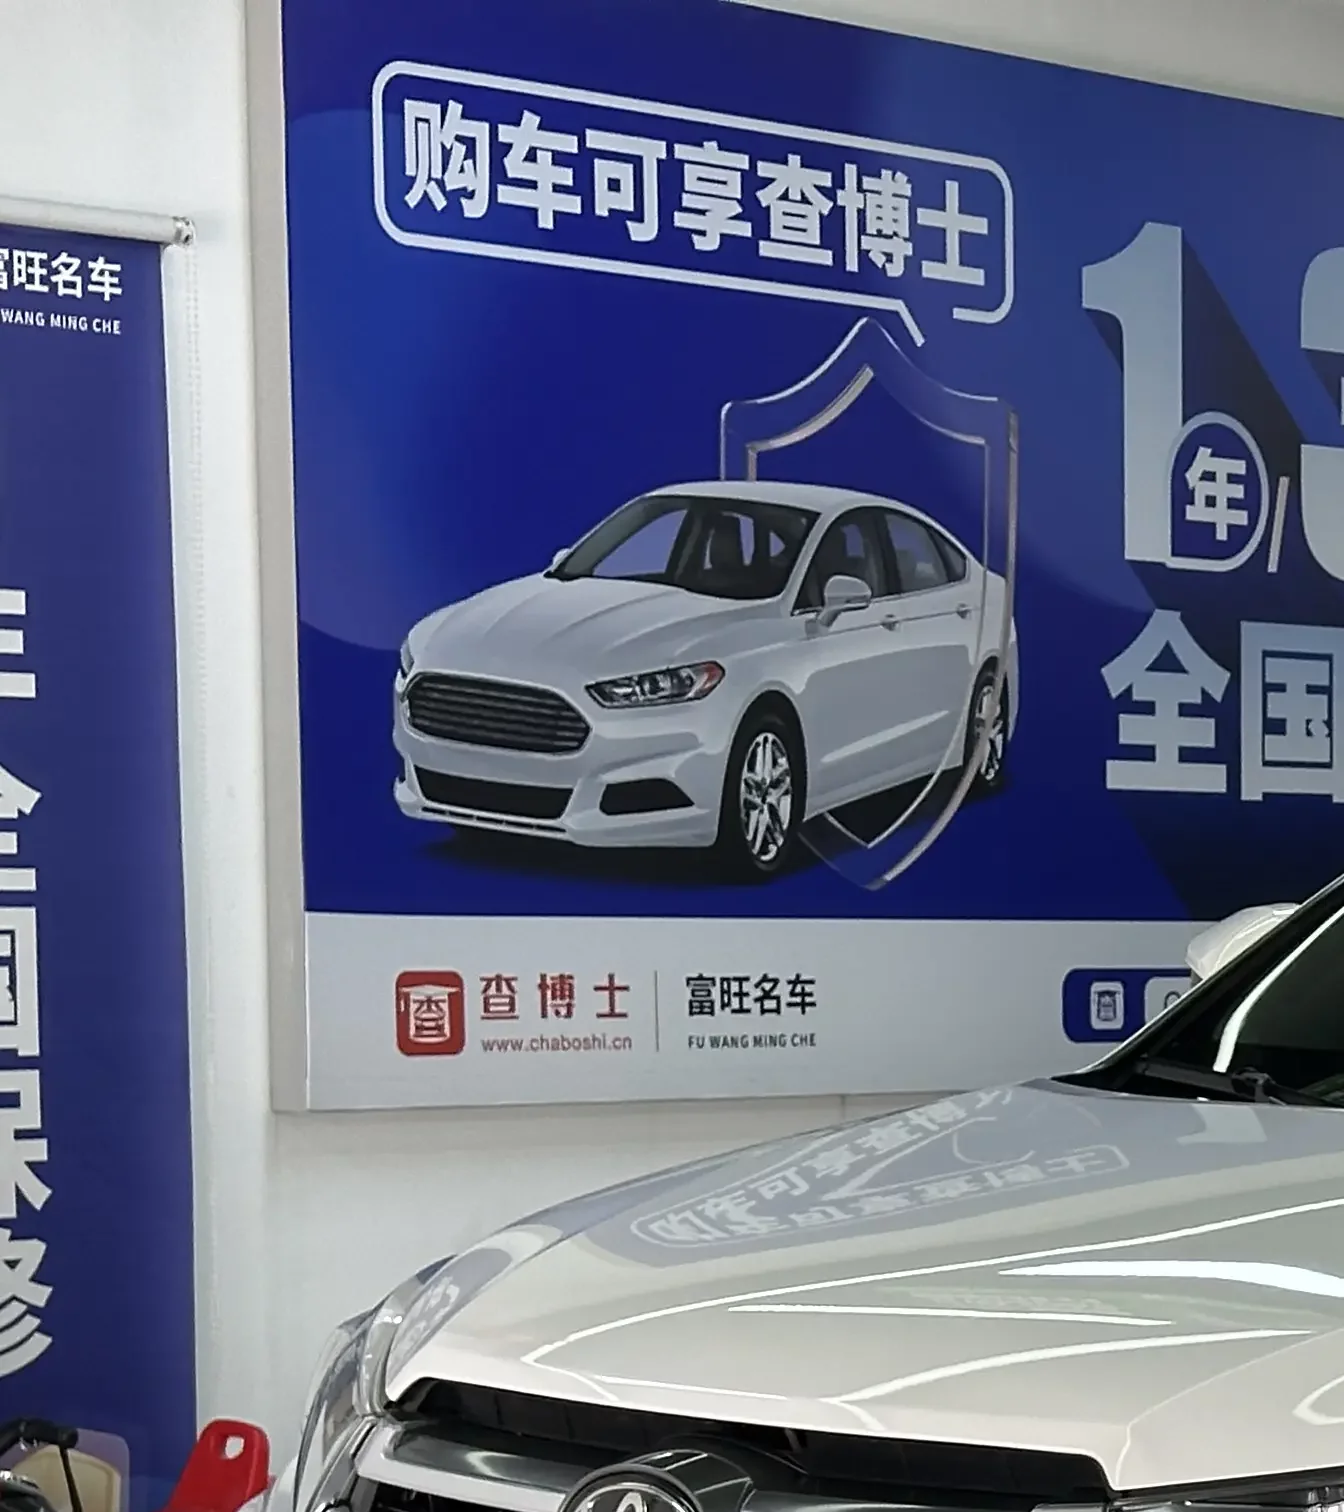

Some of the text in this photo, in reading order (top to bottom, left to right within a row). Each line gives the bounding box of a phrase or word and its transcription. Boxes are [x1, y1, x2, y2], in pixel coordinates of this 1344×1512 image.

[403, 99, 989, 287] 购车可享查博士
[0, 308, 121, 335] WANG MING CHE
[479, 973, 631, 1021] 查博士
[686, 973, 818, 1017] 富旺名车
[481, 1033, 633, 1053] www.chaboshi.cn
[688, 1033, 818, 1050] FU WANG MING CHE
